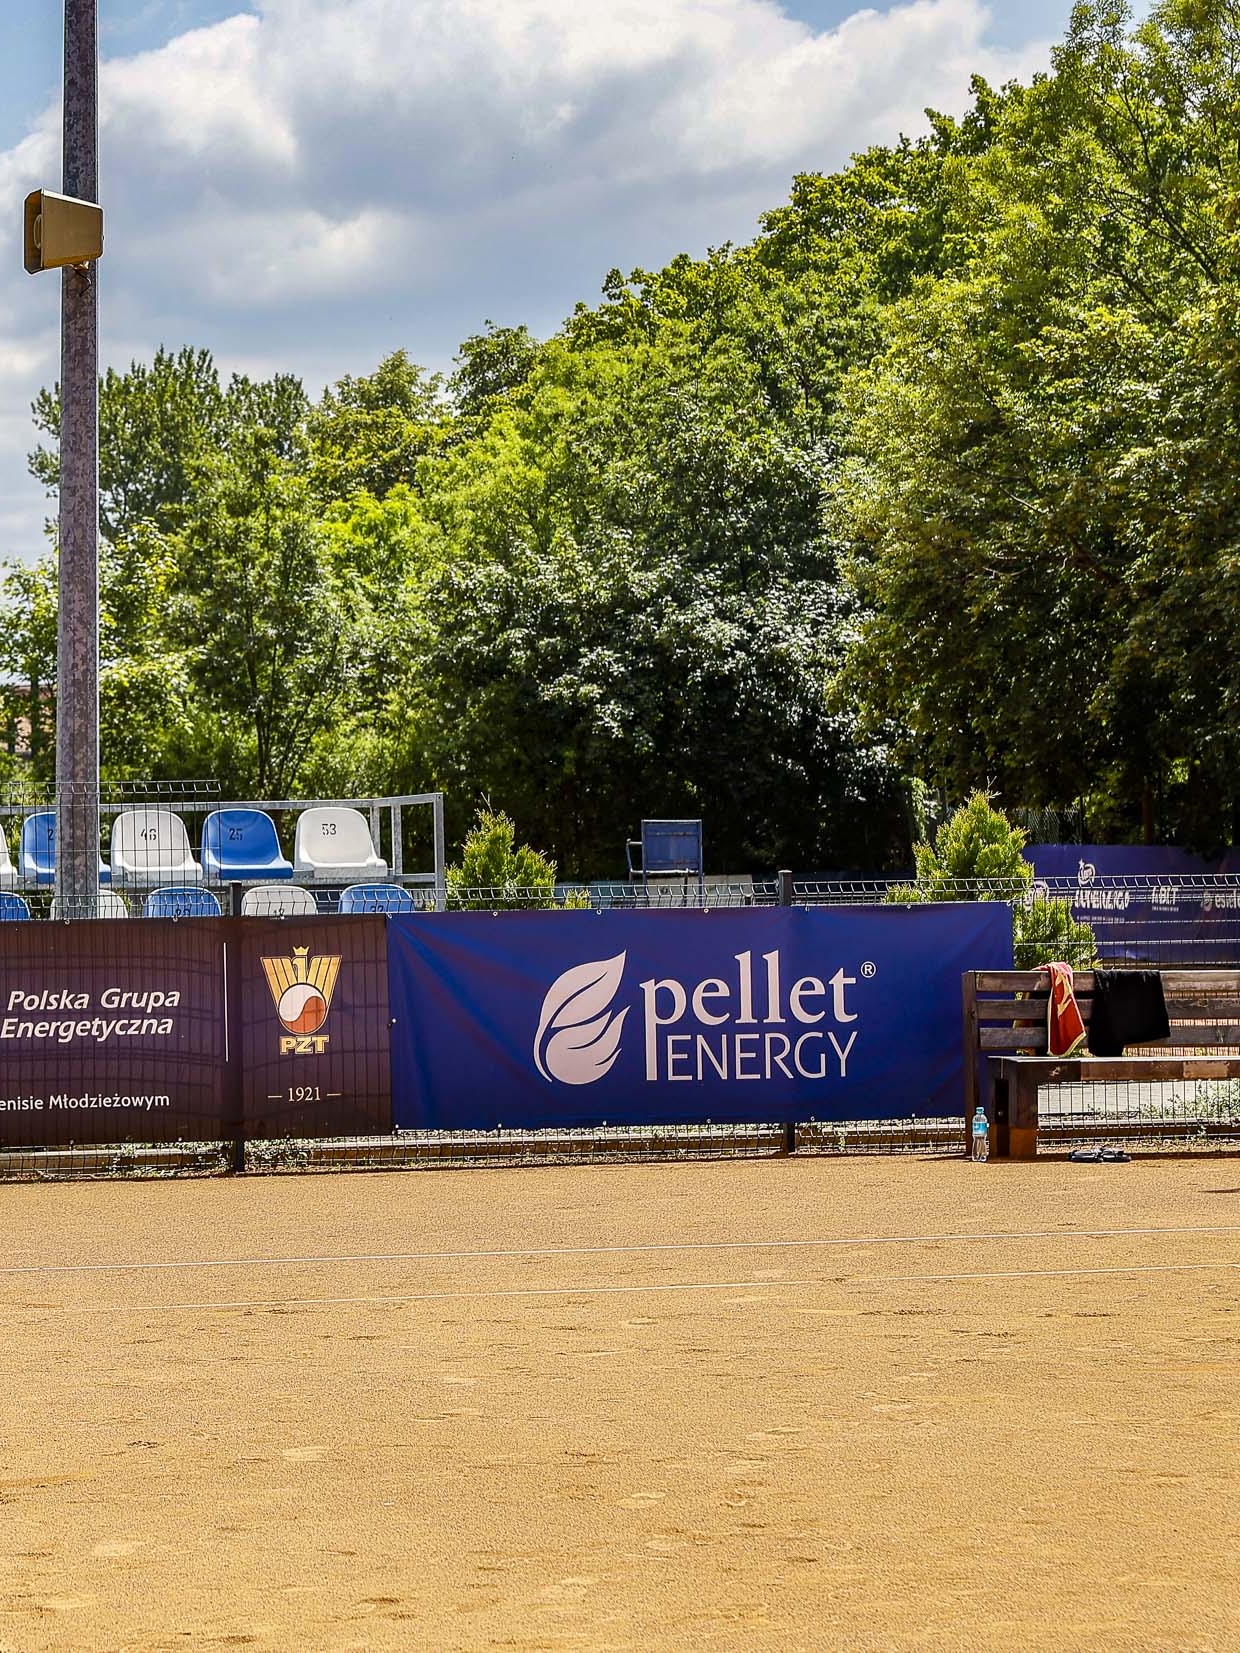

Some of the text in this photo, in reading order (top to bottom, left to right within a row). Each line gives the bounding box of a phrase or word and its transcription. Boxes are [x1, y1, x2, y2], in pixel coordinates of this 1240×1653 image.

[229, 828, 243, 841] 25
[322, 823, 337, 836] 53
[8, 988, 180, 1012] Polska Grupa
[1, 1017, 173, 1042] Energetyczna
[280, 1035, 330, 1055] PZT
[668, 1032, 857, 1080] ENERGY
[49, 1094, 169, 1110] Młodzieżowym
[289, 1087, 320, 1101] 1921
